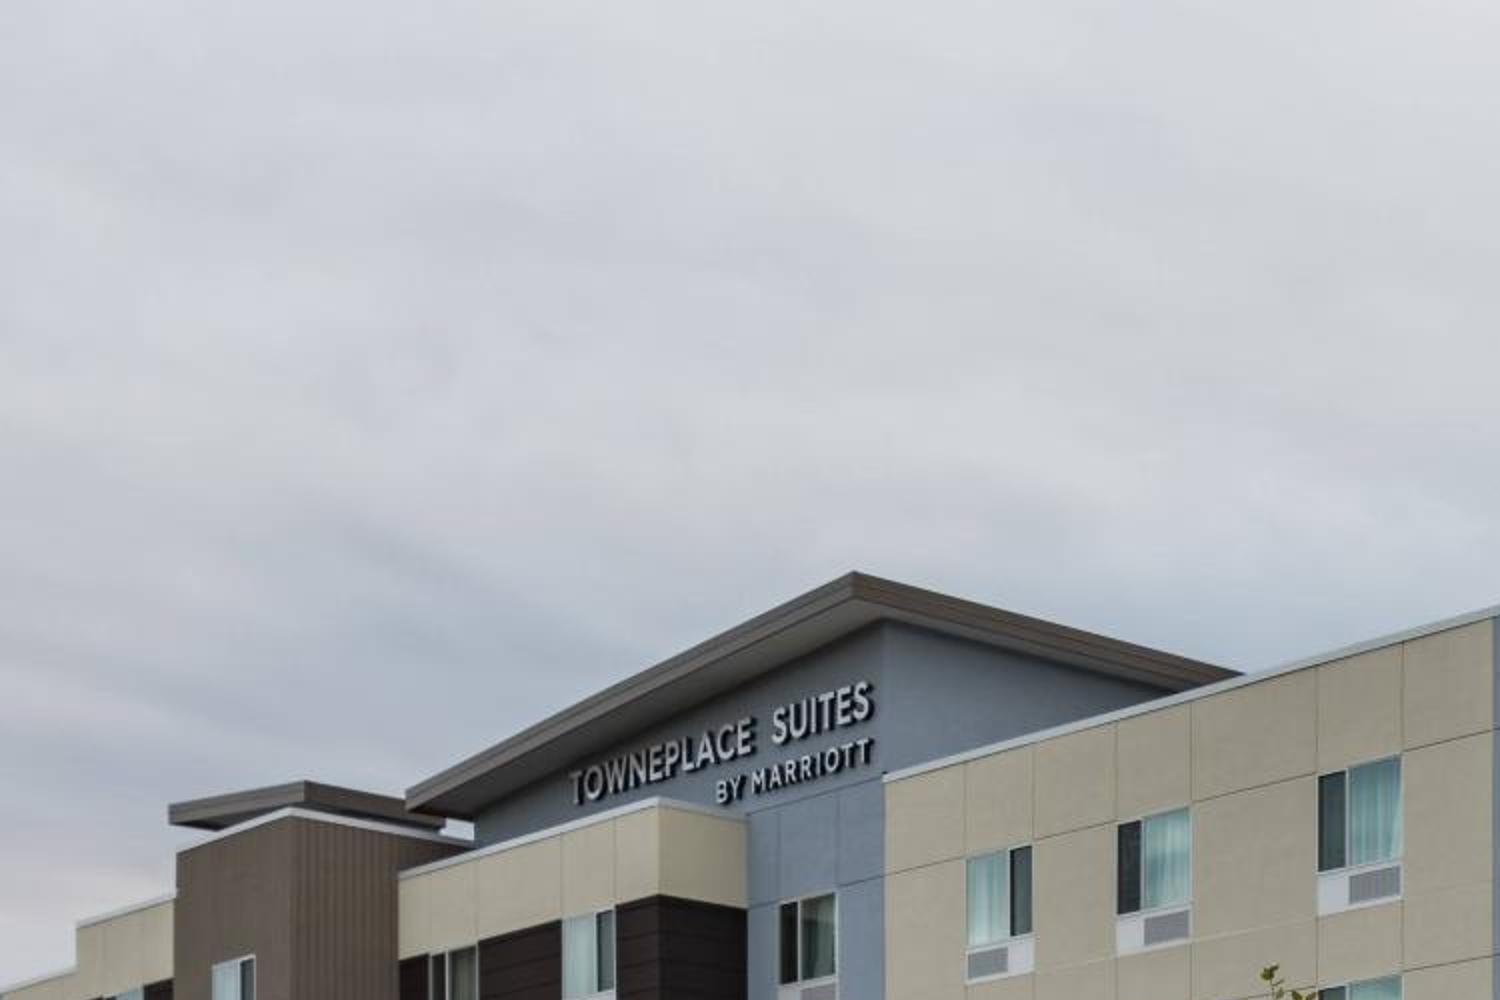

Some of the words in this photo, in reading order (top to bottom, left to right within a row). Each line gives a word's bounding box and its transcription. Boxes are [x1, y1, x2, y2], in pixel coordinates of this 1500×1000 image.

[569, 717, 754, 803] TOWNEPLACE
[771, 681, 873, 743] SUITES
[716, 774, 747, 803] BY
[751, 737, 873, 794] MARRIOTT
